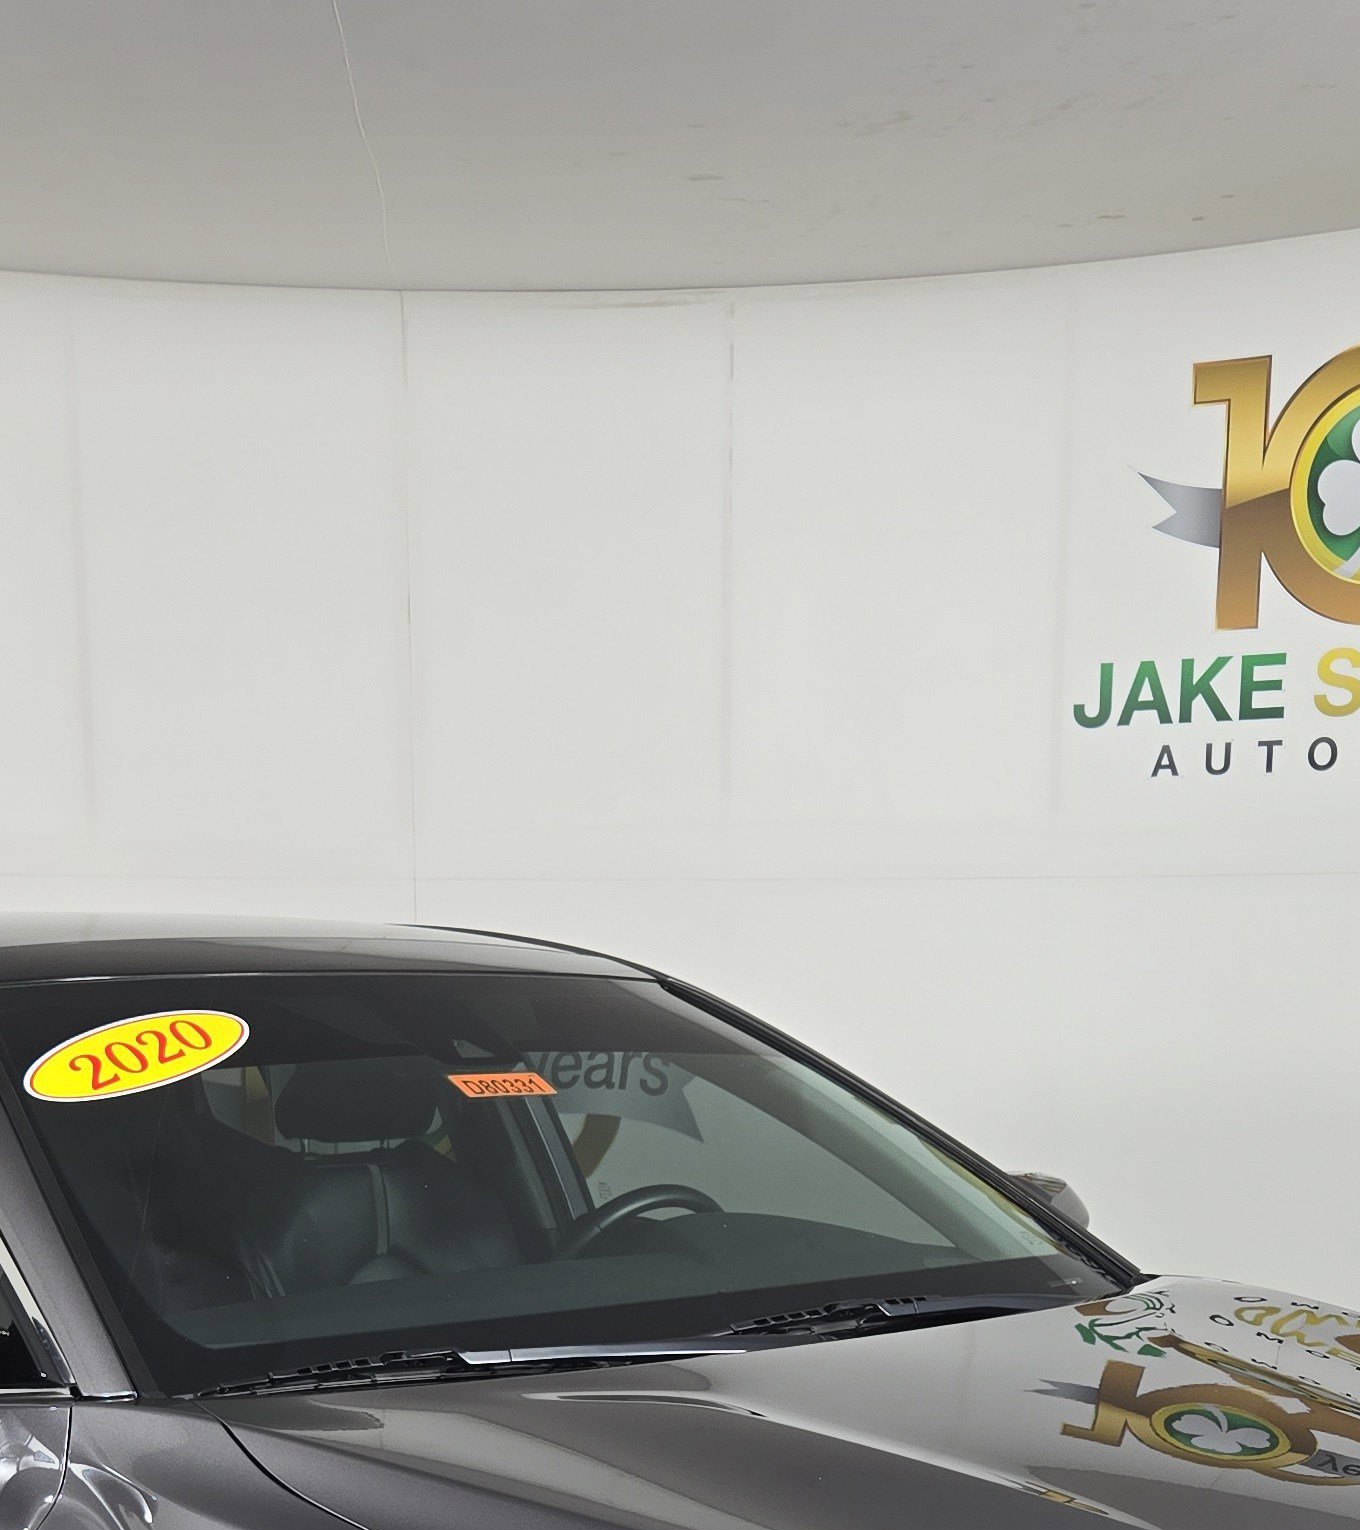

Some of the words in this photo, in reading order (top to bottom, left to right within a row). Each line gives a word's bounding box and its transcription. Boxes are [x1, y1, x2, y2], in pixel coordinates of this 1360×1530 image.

[1071, 652, 1288, 730] JAKE
[68, 1020, 213, 1091] 2020
[533, 1050, 671, 1097] ears
[461, 1076, 546, 1095] D80331
